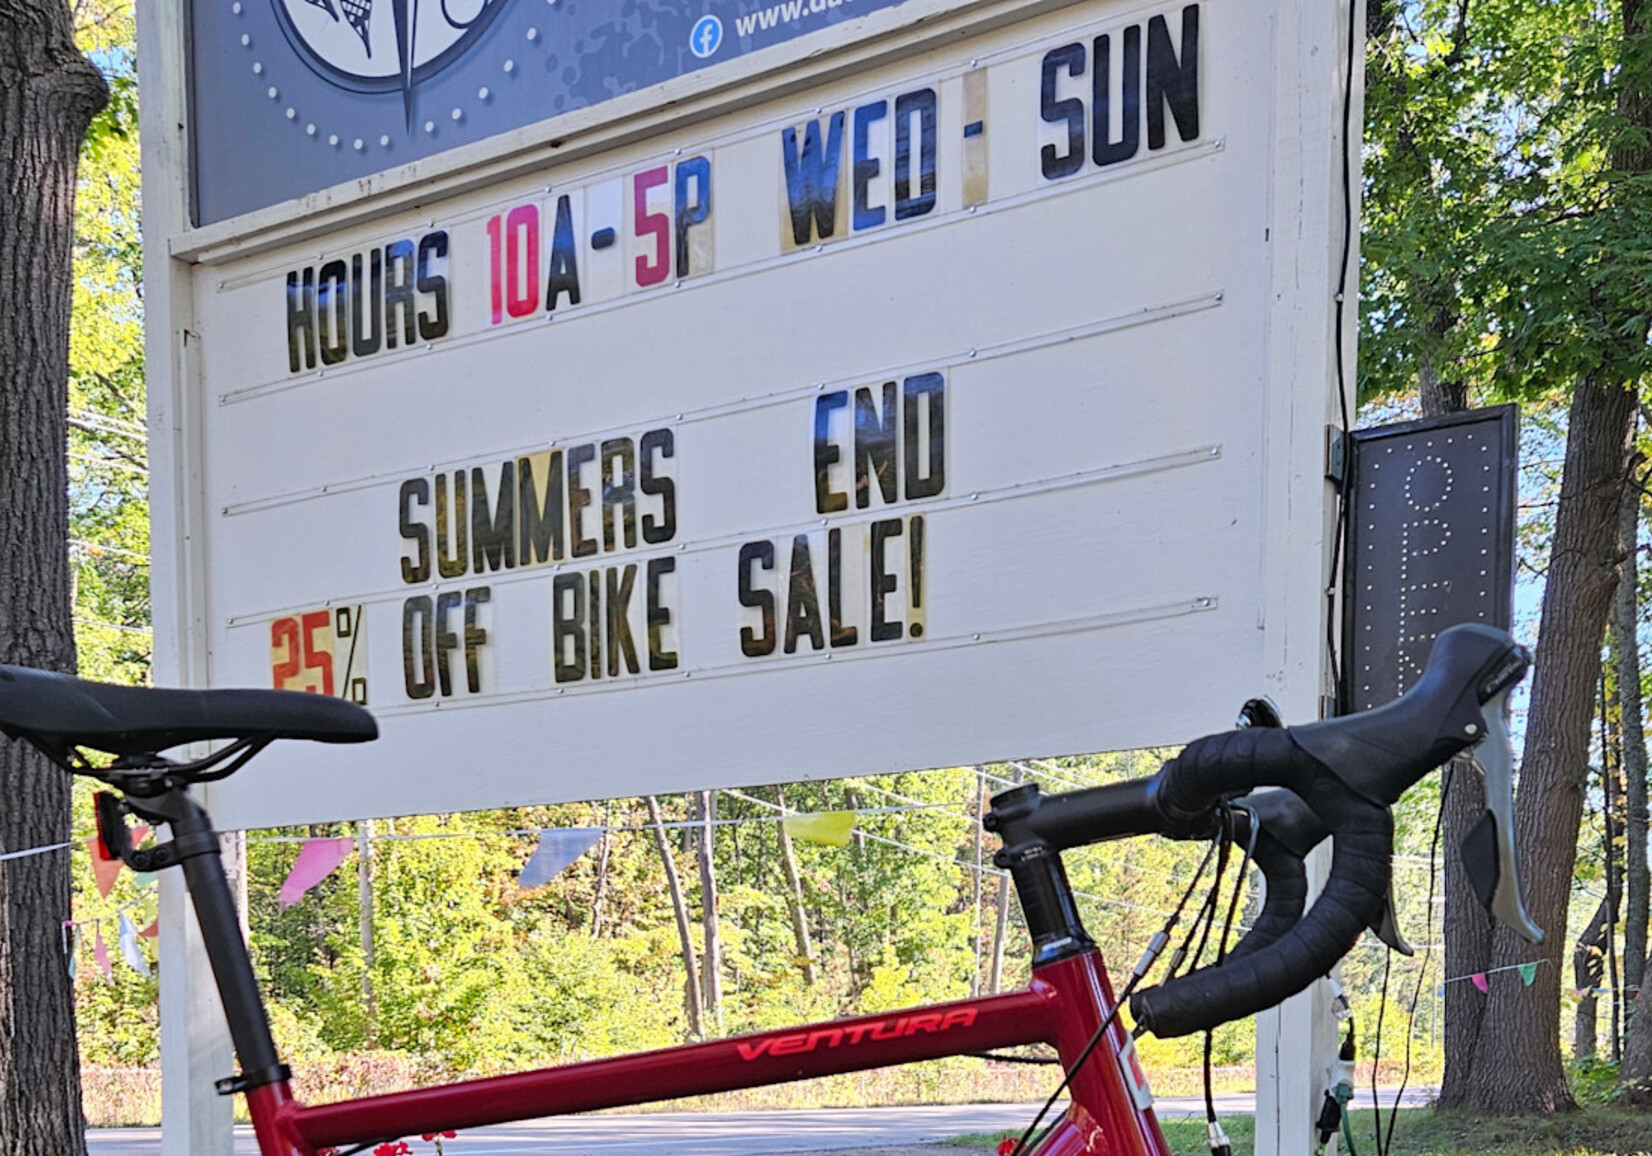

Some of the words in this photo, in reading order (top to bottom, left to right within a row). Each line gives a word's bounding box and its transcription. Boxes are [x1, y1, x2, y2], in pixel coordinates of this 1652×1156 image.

[735, 0, 853, 38] www.
[286, 229, 450, 374] HOURS
[1040, 3, 1200, 181] SUN
[400, 427, 677, 585] SUMMERS
[815, 371, 946, 514] END
[271, 604, 367, 706] 25%
[403, 585, 492, 700] OFF
[552, 555, 679, 684] BIKE
[738, 514, 925, 658] SALE!
[735, 1007, 979, 1061] VENTURA
